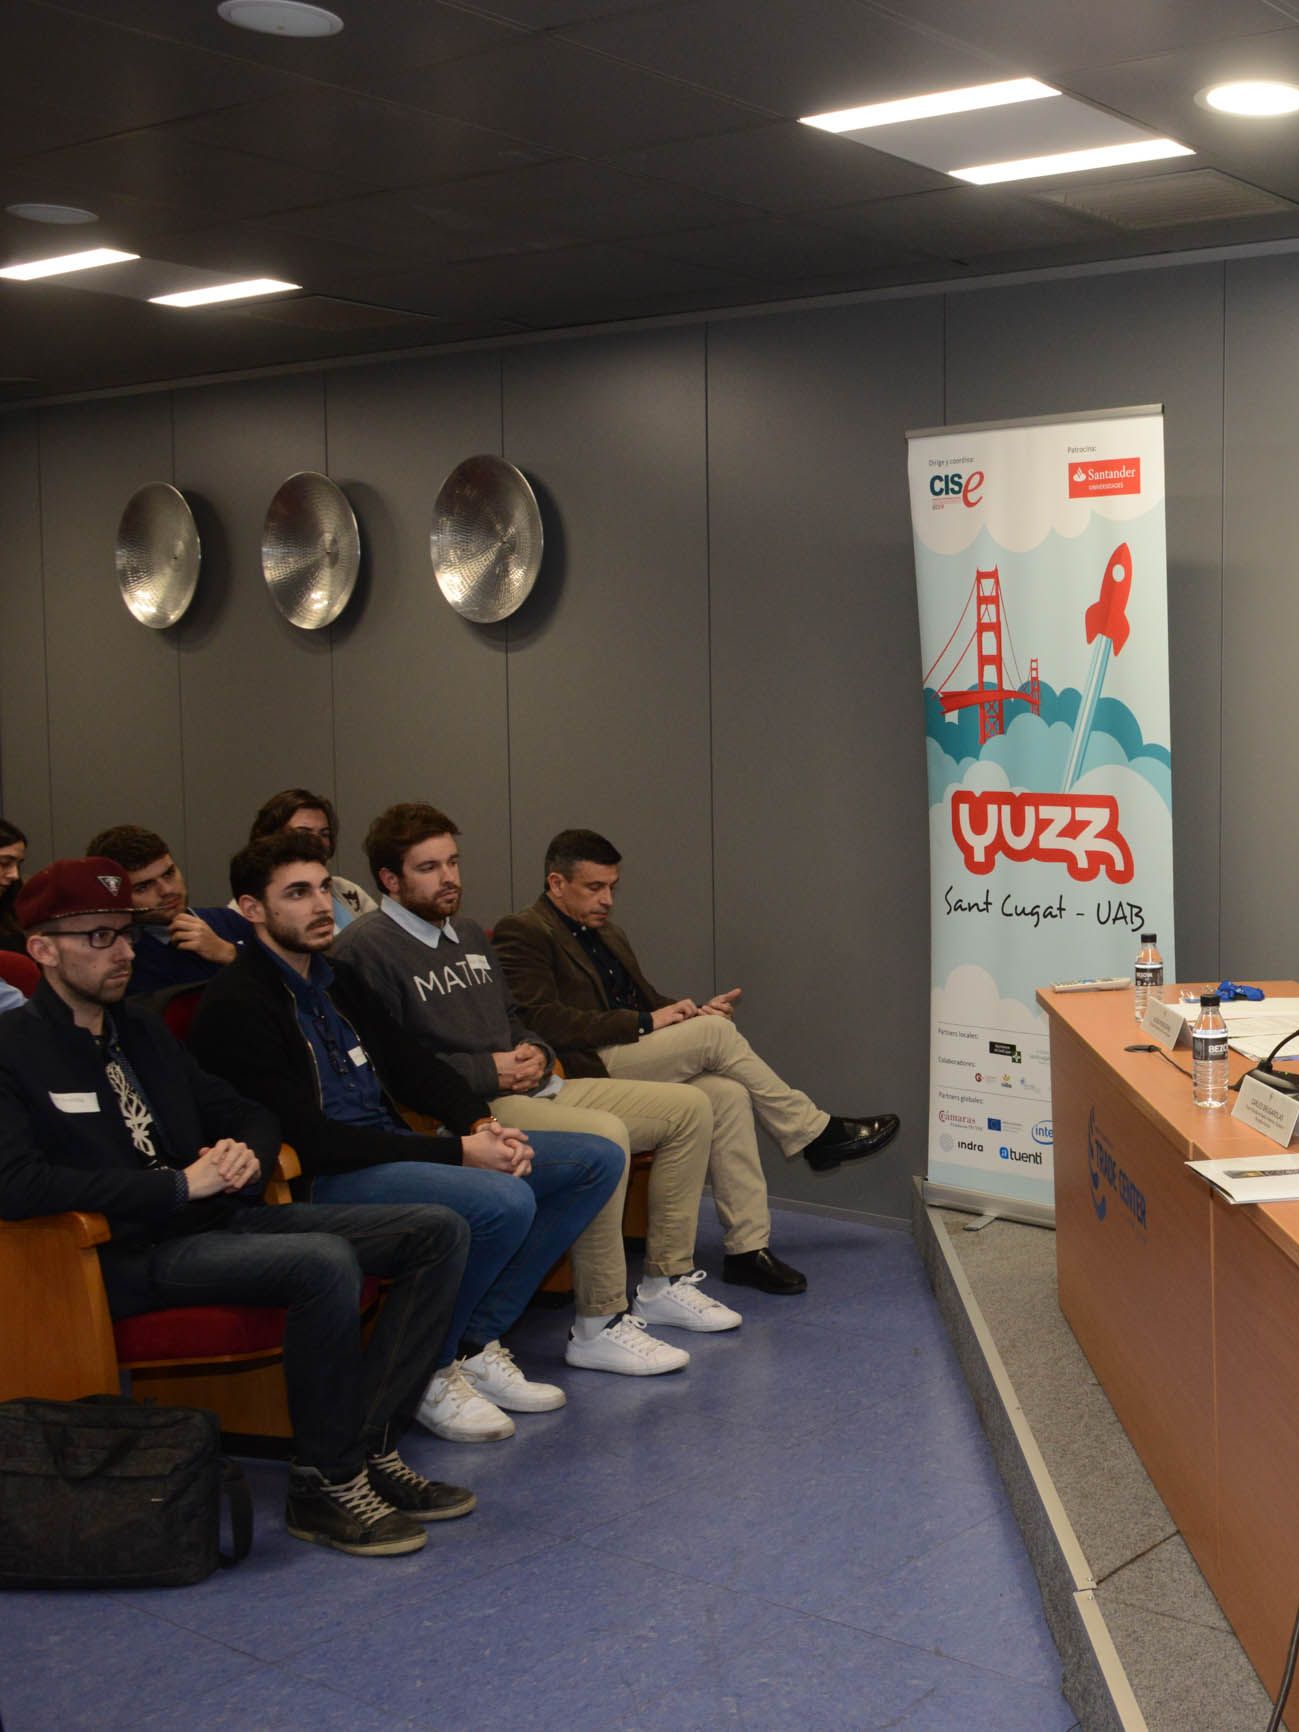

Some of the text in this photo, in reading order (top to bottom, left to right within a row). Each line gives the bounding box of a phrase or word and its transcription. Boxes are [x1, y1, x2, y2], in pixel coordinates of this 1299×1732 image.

[1088, 465, 1136, 481] Santander
[944, 886, 993, 915] Sant
[1001, 894, 1067, 927] Cugat
[1096, 900, 1145, 932] UAB
[1035, 1123, 1054, 1138] inte
[957, 1141, 984, 1152] indra
[1009, 1148, 1043, 1165] tuenti
